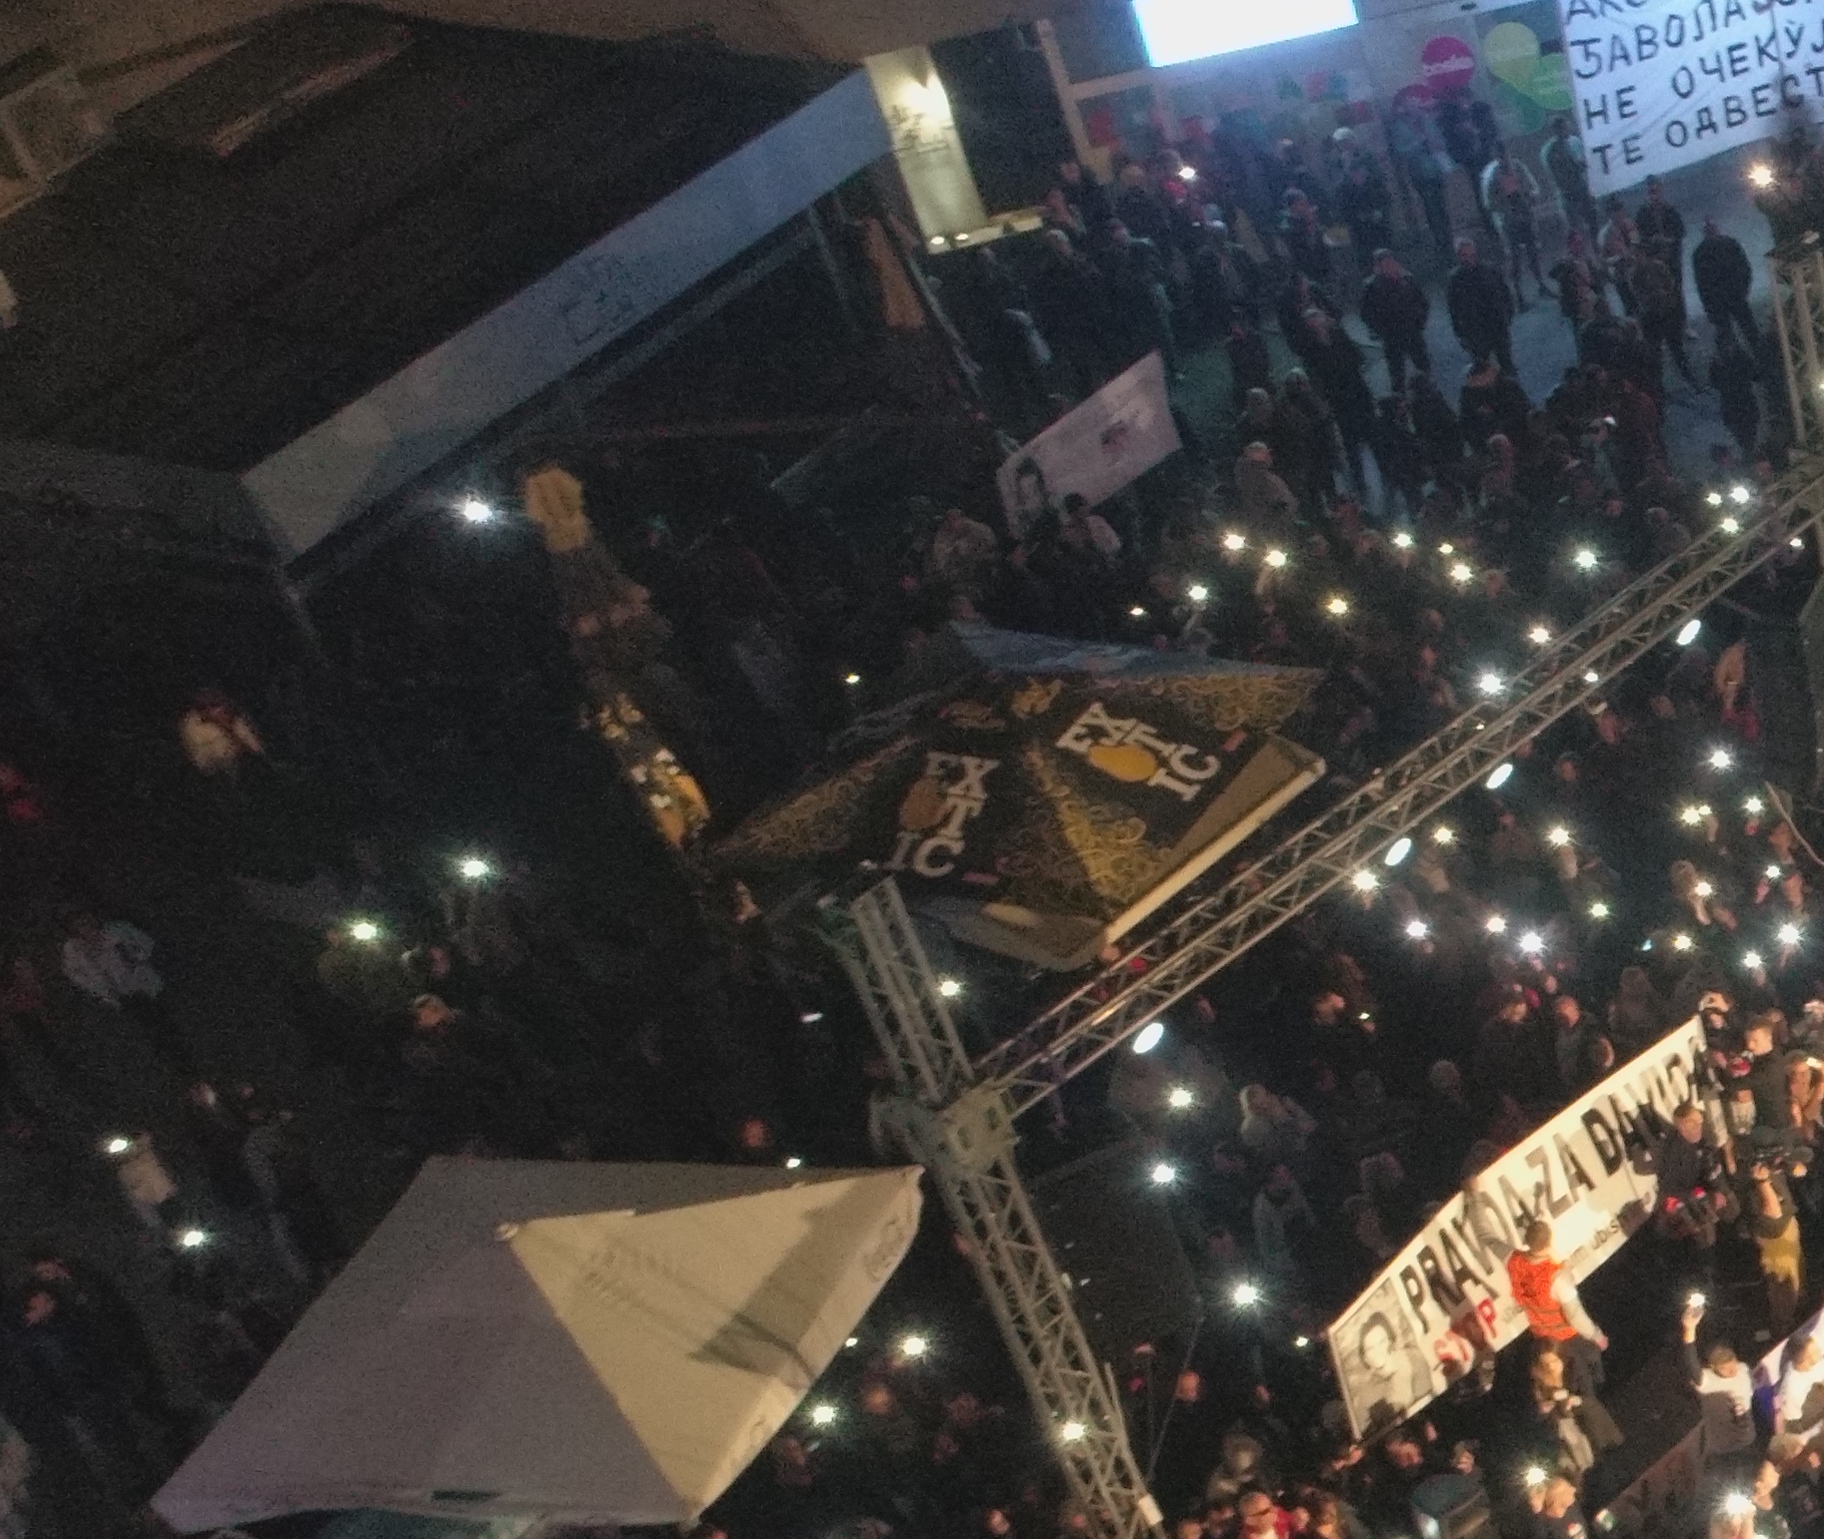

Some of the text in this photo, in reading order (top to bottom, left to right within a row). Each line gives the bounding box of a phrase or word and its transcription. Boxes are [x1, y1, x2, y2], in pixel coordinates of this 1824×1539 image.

[1584, 86, 1638, 131] НЕ
[1593, 132, 1643, 175] ТЕ
[1525, 1133, 1596, 1218] ZA
